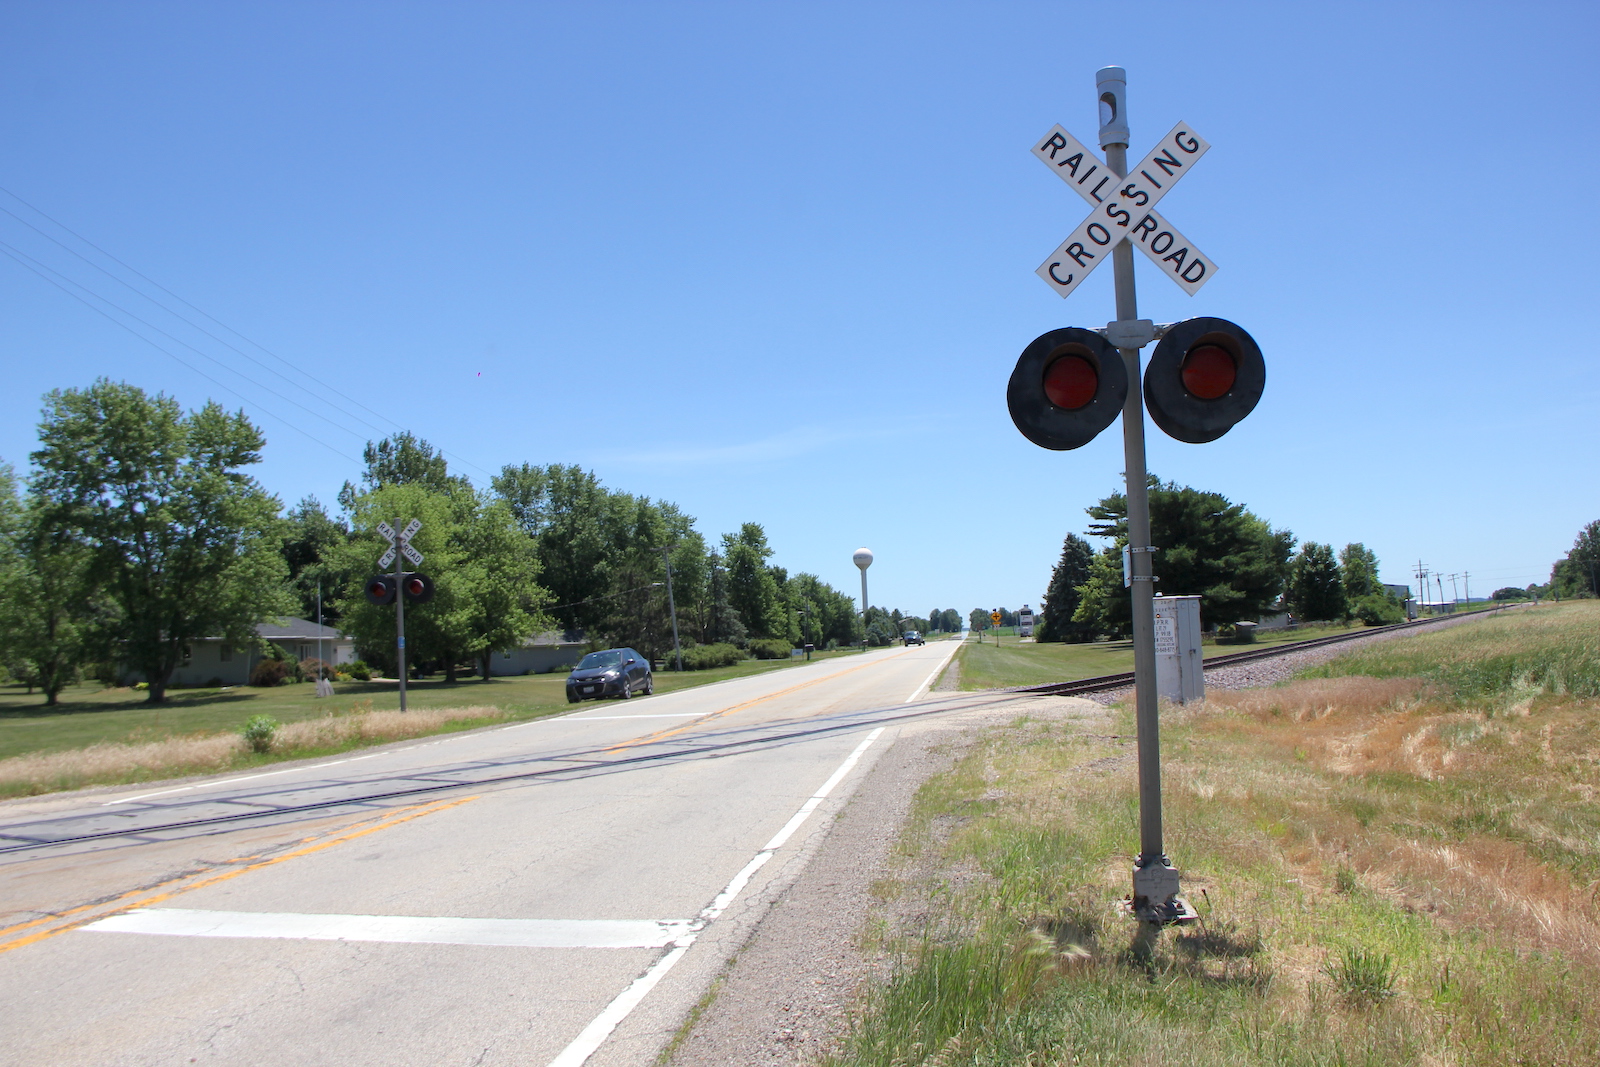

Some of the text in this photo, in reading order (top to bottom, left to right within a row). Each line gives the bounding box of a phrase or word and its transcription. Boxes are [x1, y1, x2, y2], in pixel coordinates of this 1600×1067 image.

[1040, 131, 1206, 284] RAIL ROAD
[1048, 131, 1200, 286] CROSSING
[381, 521, 420, 566] CROING
[402, 544, 420, 563] ROAD
